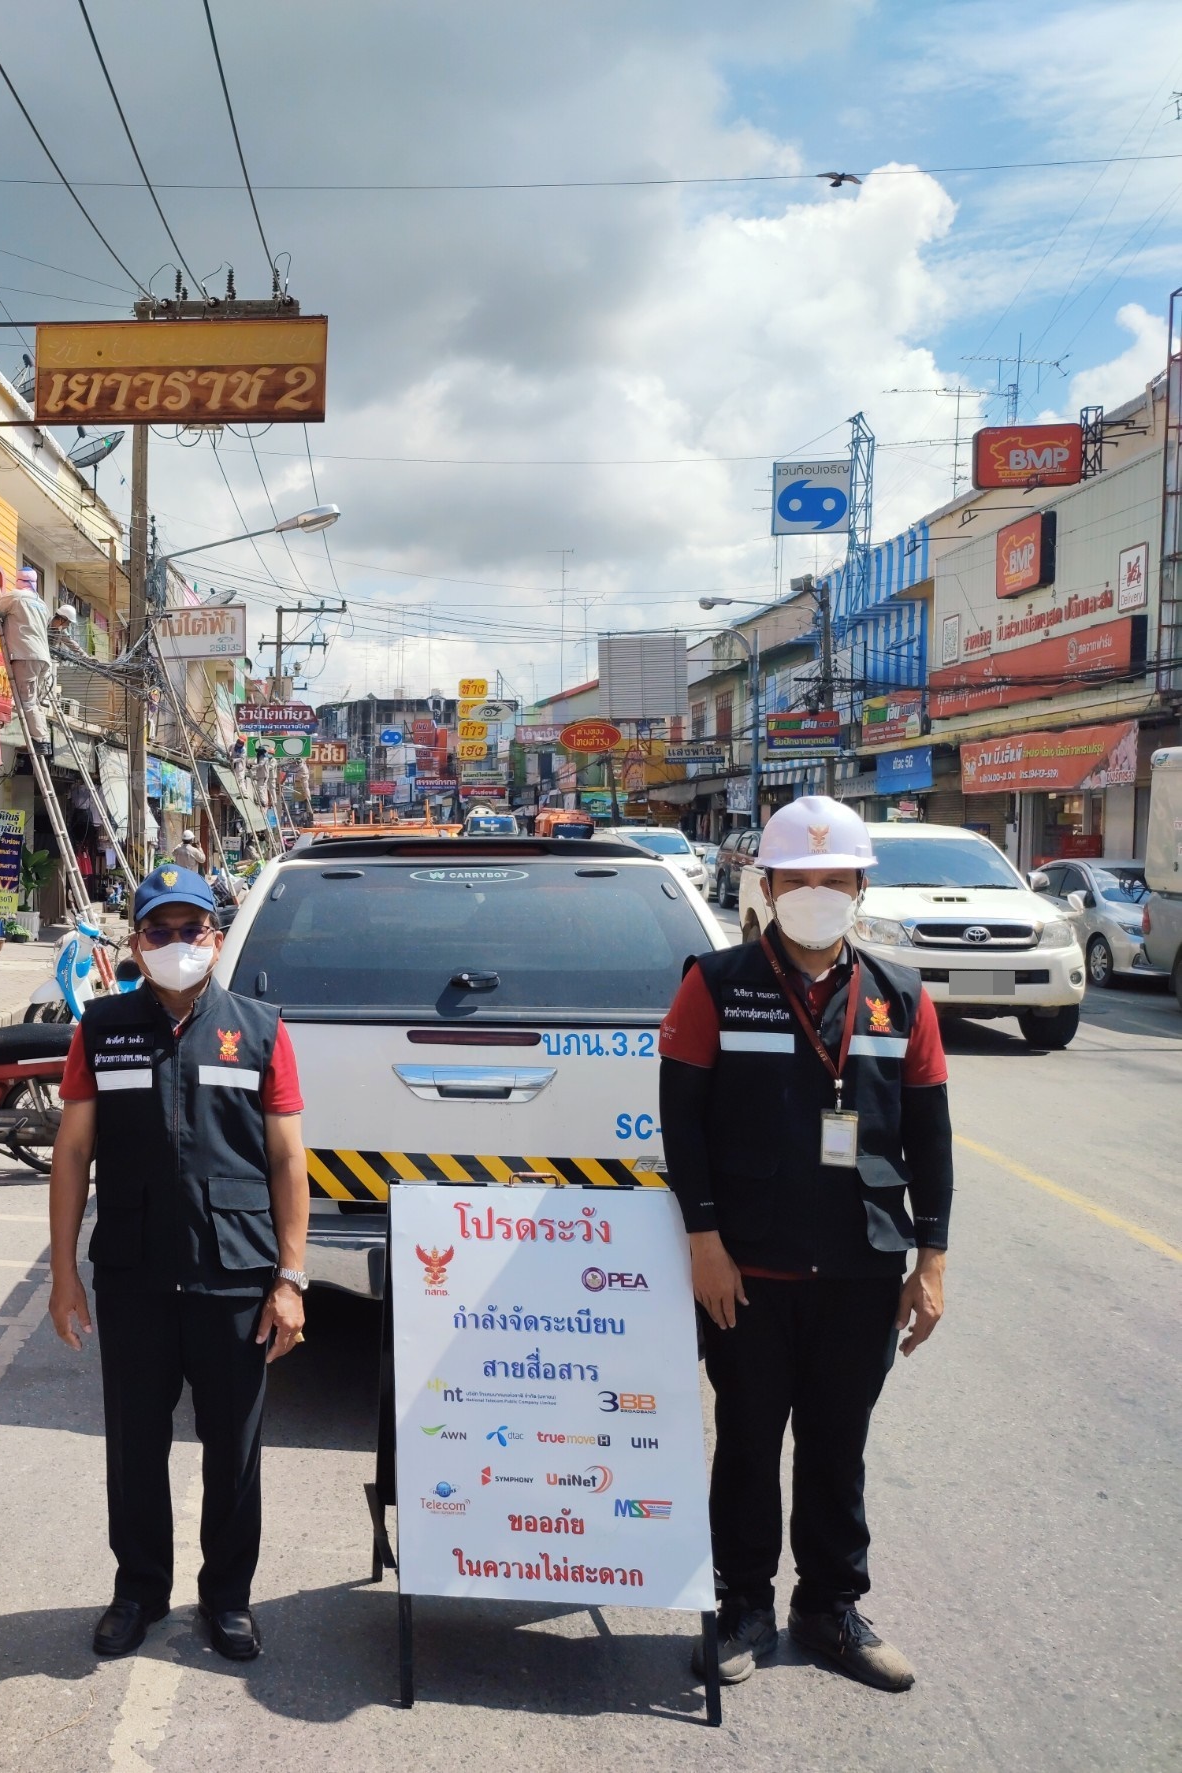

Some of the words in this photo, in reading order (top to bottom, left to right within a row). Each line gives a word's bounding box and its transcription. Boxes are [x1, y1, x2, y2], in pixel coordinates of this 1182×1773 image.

[44, 367, 276, 413] เยาวราช
[274, 366, 317, 411] 2
[1009, 447, 1070, 470] BMP
[777, 464, 850, 476] แว่นท็อปเจริญ
[1009, 543, 1035, 574] BMP
[1120, 591, 1143, 607] Delivery
[161, 610, 236, 638] างใต้ฟ้า
[239, 706, 311, 720] ร้านโตเกียว
[460, 722, 485, 737] ก้าว
[892, 757, 904, 770] dtac
[904, 755, 914, 768] 5G
[449, 870, 510, 880] CARRYBOY
[542, 1031, 655, 1057] บภน.3.2
[452, 1202, 612, 1244] โปรดระวัง
[607, 1272, 649, 1288] PEA
[424, 1287, 451, 1297] กสทช.
[453, 1304, 625, 1336] กำลังจัดระเบียบ
[482, 1348, 599, 1382] สายสื่อสาร
[443, 1387, 464, 1403] nt
[598, 1391, 656, 1413] 3BB
[440, 1430, 467, 1441] AWN
[507, 1430, 524, 1441] dtac
[631, 1437, 659, 1449] UIH
[494, 1475, 534, 1484] SYMPHONY
[546, 1472, 597, 1488] UniNet
[420, 1498, 466, 1511] Telecom
[614, 1499, 656, 1519] MSS
[507, 1507, 585, 1535] ขออภัย
[452, 1548, 644, 1588] ในความไม่สะดวก
